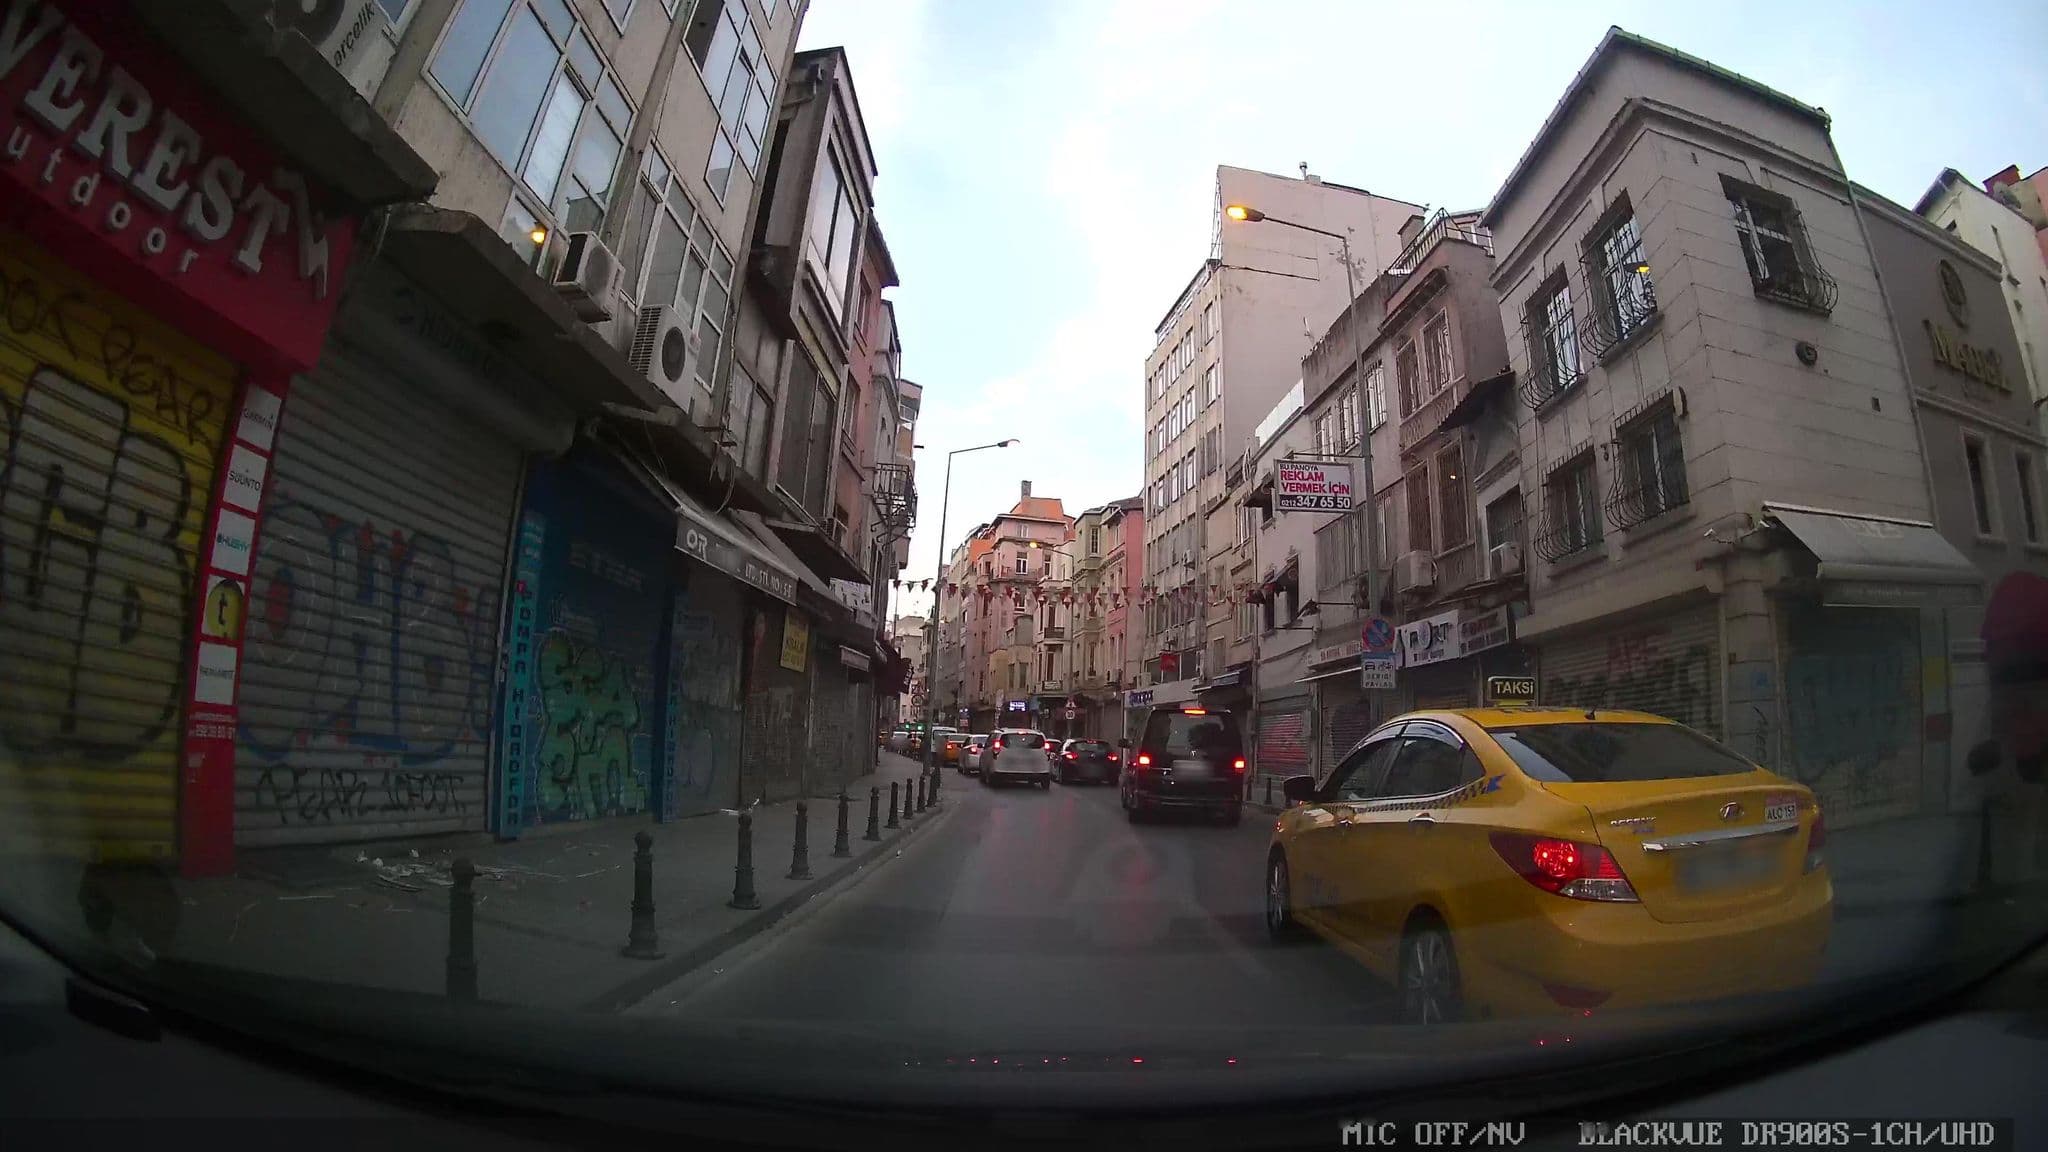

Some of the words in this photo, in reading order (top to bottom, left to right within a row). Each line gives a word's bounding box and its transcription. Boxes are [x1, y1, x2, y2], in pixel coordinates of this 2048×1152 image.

[1291, 464, 1319, 472] PANOYA
[229, 470, 261, 492] SUUNTO
[1281, 471, 1324, 482] REKLAM
[1281, 482, 1327, 494] VERMEK
[1297, 495, 1317, 507] 347
[1320, 496, 1334, 508] 65
[1336, 496, 1351, 509] 50
